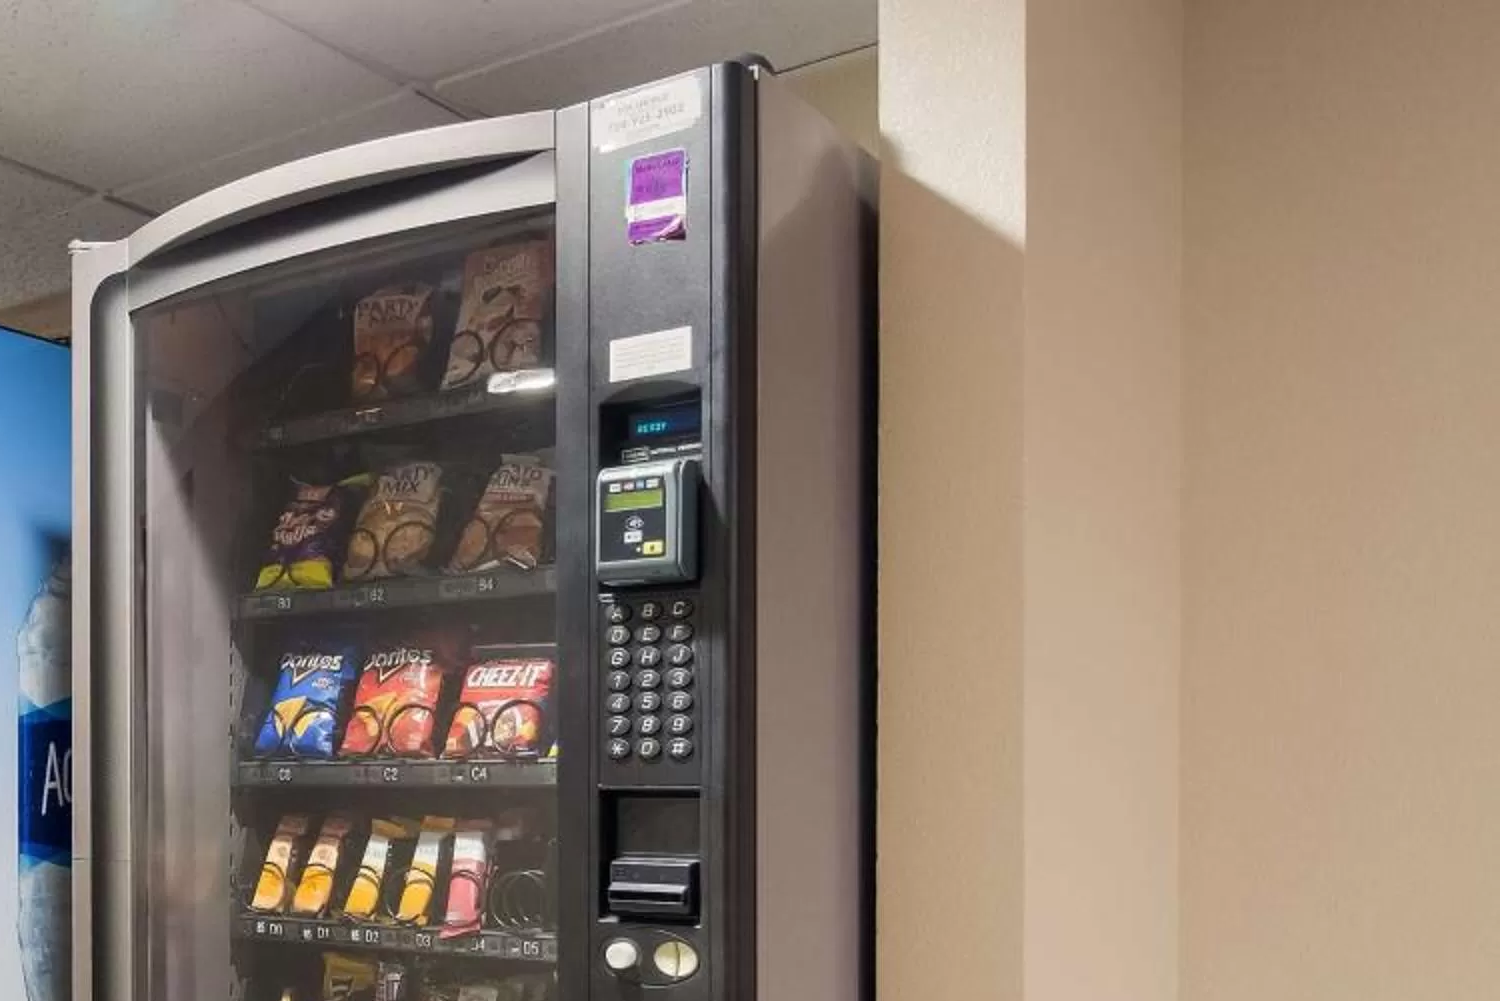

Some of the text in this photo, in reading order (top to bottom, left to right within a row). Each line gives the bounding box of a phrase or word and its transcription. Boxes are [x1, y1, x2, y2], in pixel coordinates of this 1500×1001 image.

[642, 603, 655, 618] B
[672, 601, 685, 616] C
[642, 627, 655, 642] E
[672, 625, 685, 640] F
[641, 650, 656, 664] H
[641, 673, 655, 688] 2
[671, 671, 685, 686] 3
[641, 695, 655, 709] 5
[671, 695, 685, 709] 6
[611, 717, 685, 733] 7 8 9
[641, 741, 654, 755] 0
[471, 766, 488, 780] C4
[365, 930, 379, 943] D2
